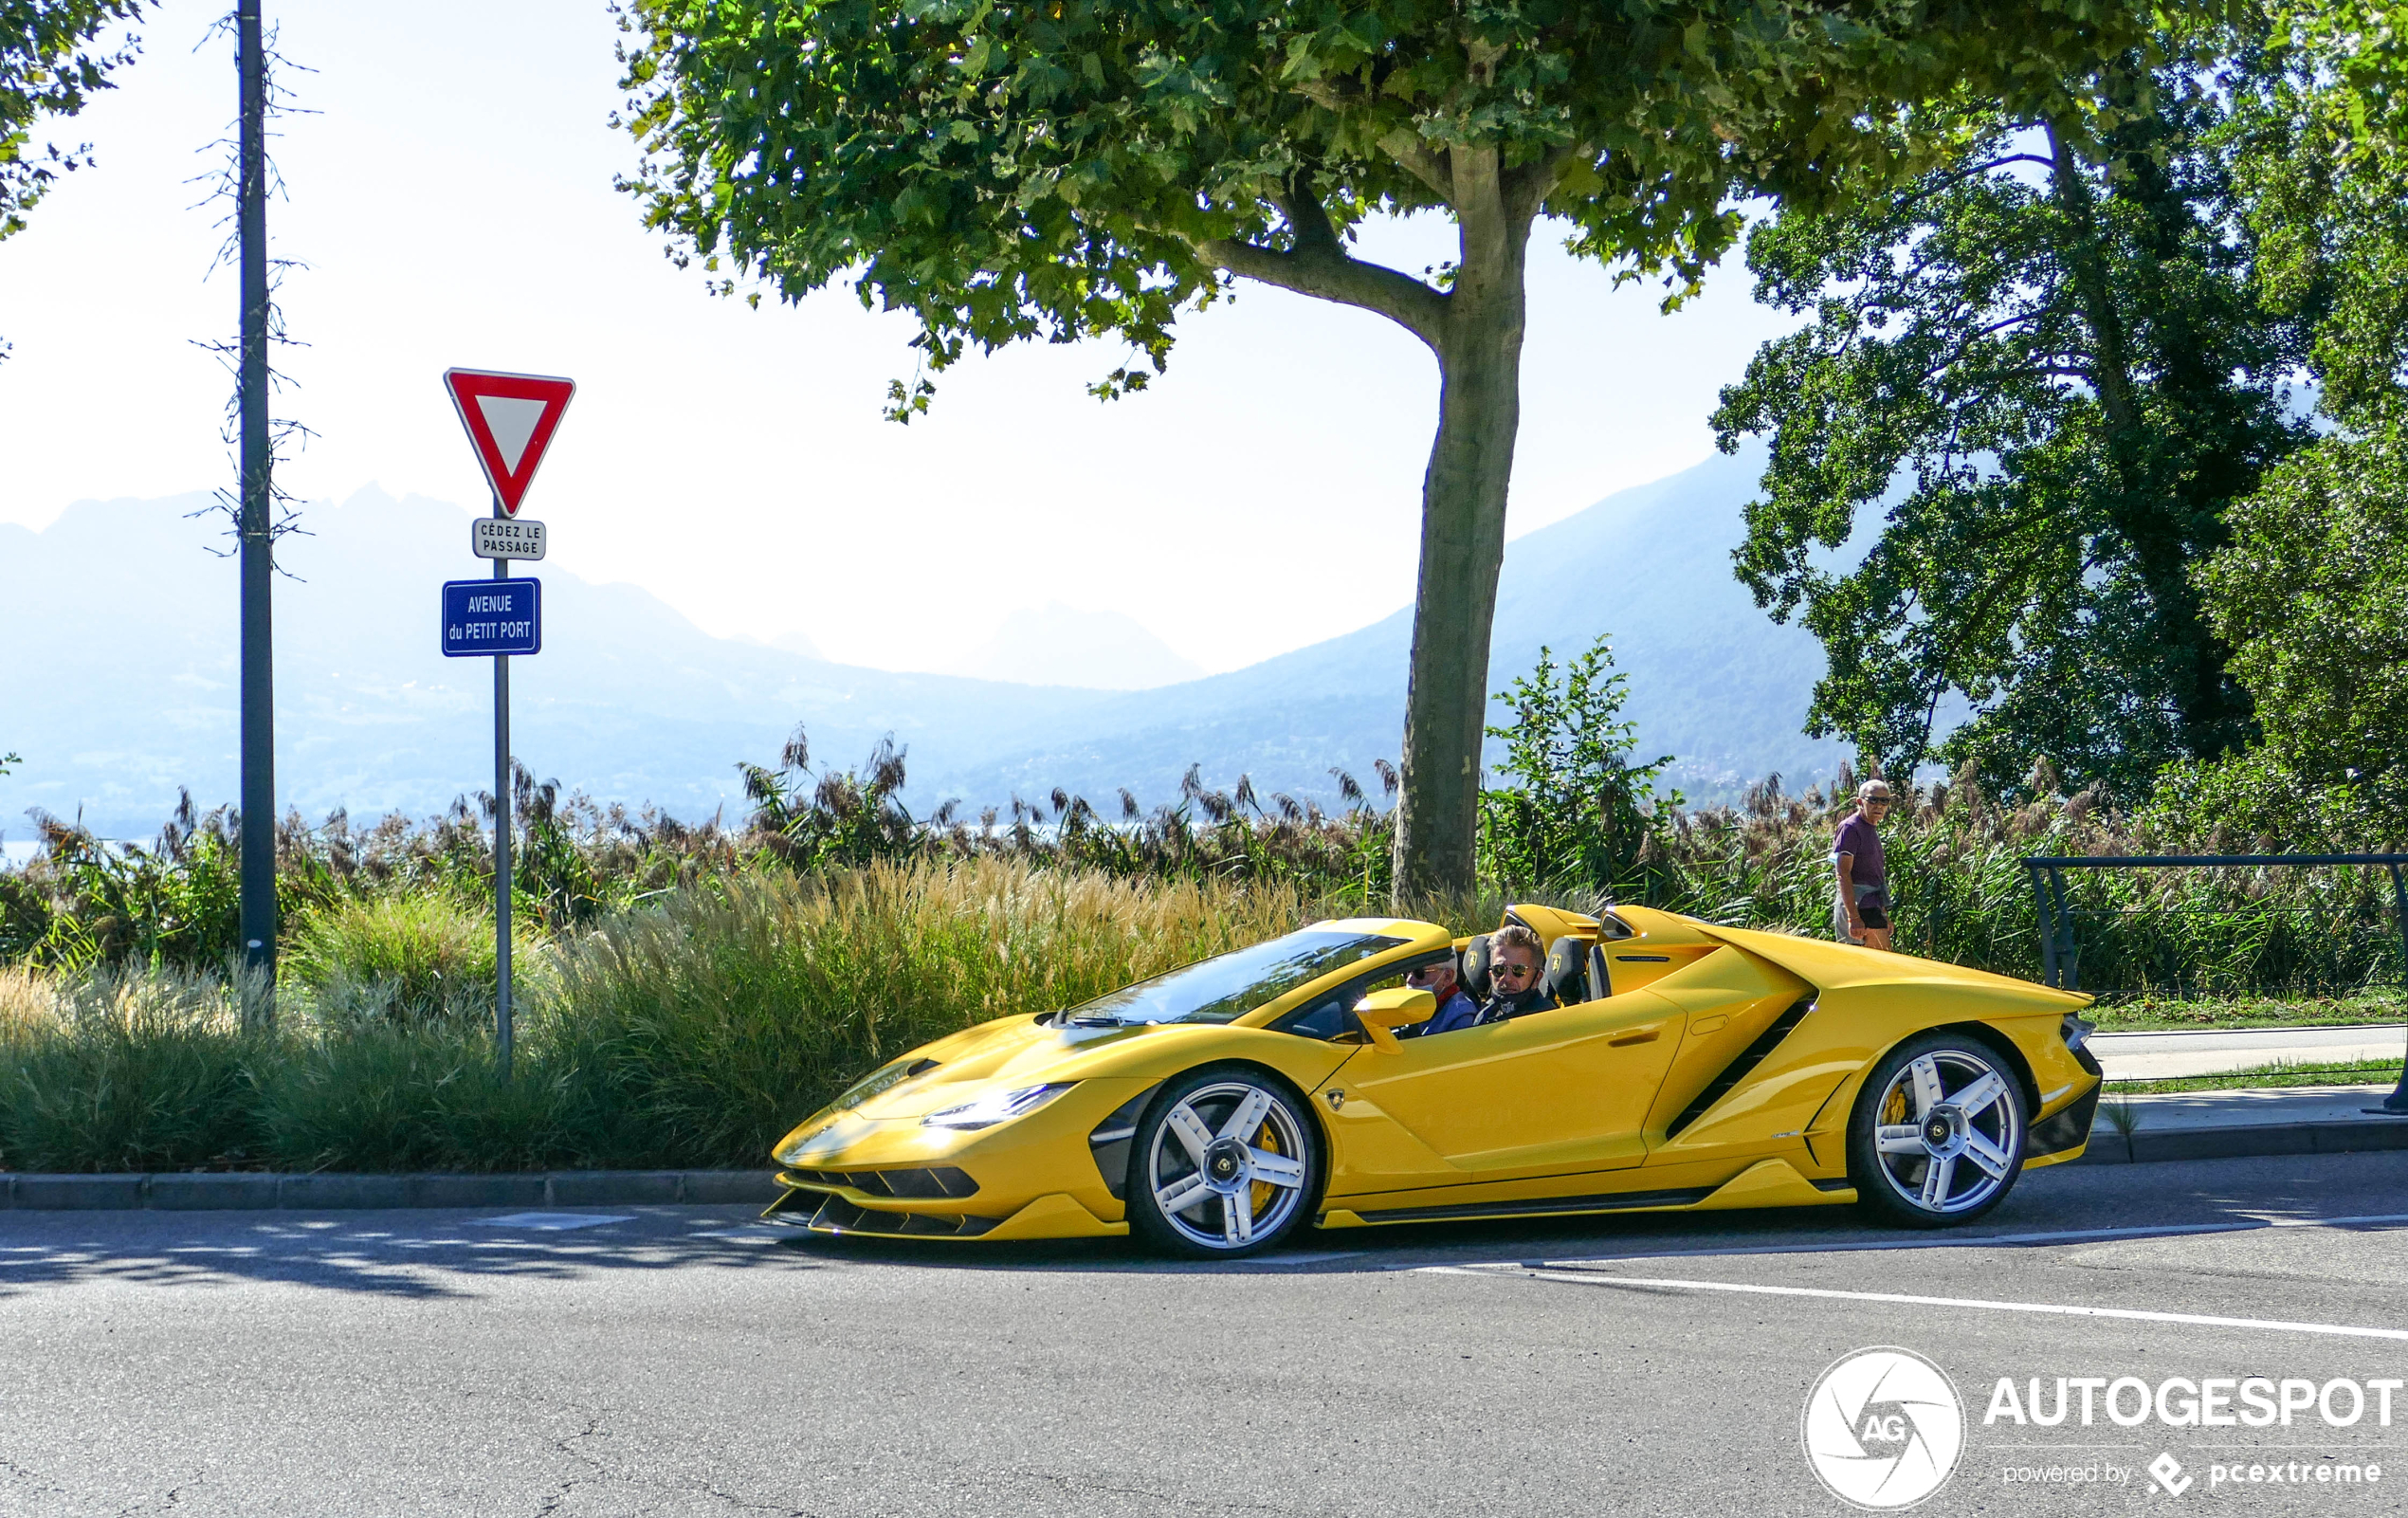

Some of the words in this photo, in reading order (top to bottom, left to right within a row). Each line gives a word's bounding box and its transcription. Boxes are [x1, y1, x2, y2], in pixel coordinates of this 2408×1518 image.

[481, 522, 520, 538] CÉDEZ
[526, 527, 540, 539] LE
[483, 540, 538, 554] PASSAGE
[467, 594, 512, 613] AVENUE
[448, 624, 463, 640] du
[465, 622, 497, 640] PETIT
[500, 621, 531, 638] PORT
